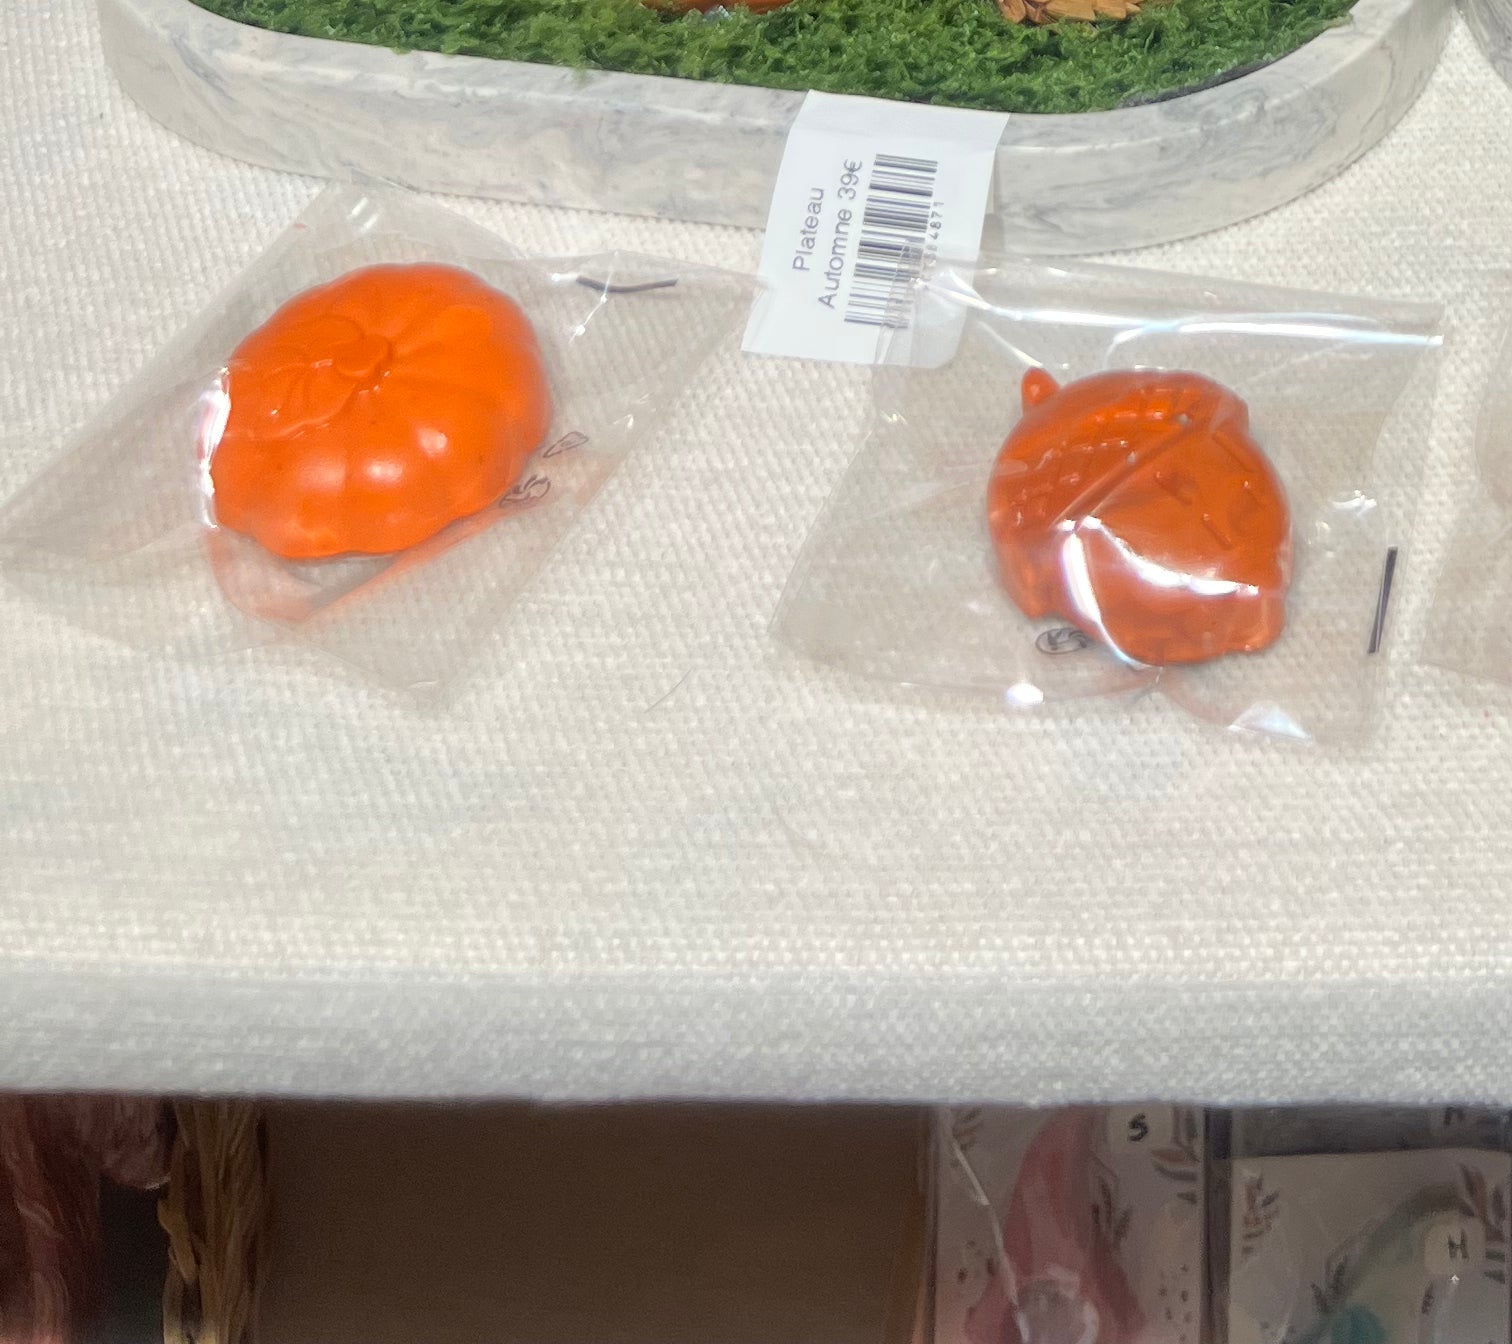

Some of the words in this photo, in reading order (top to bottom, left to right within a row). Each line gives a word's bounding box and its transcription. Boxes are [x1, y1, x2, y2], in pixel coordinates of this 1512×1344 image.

[792, 187, 825, 272] Plateau
[818, 208, 853, 310] Automne
[837, 159, 863, 201] 39€
